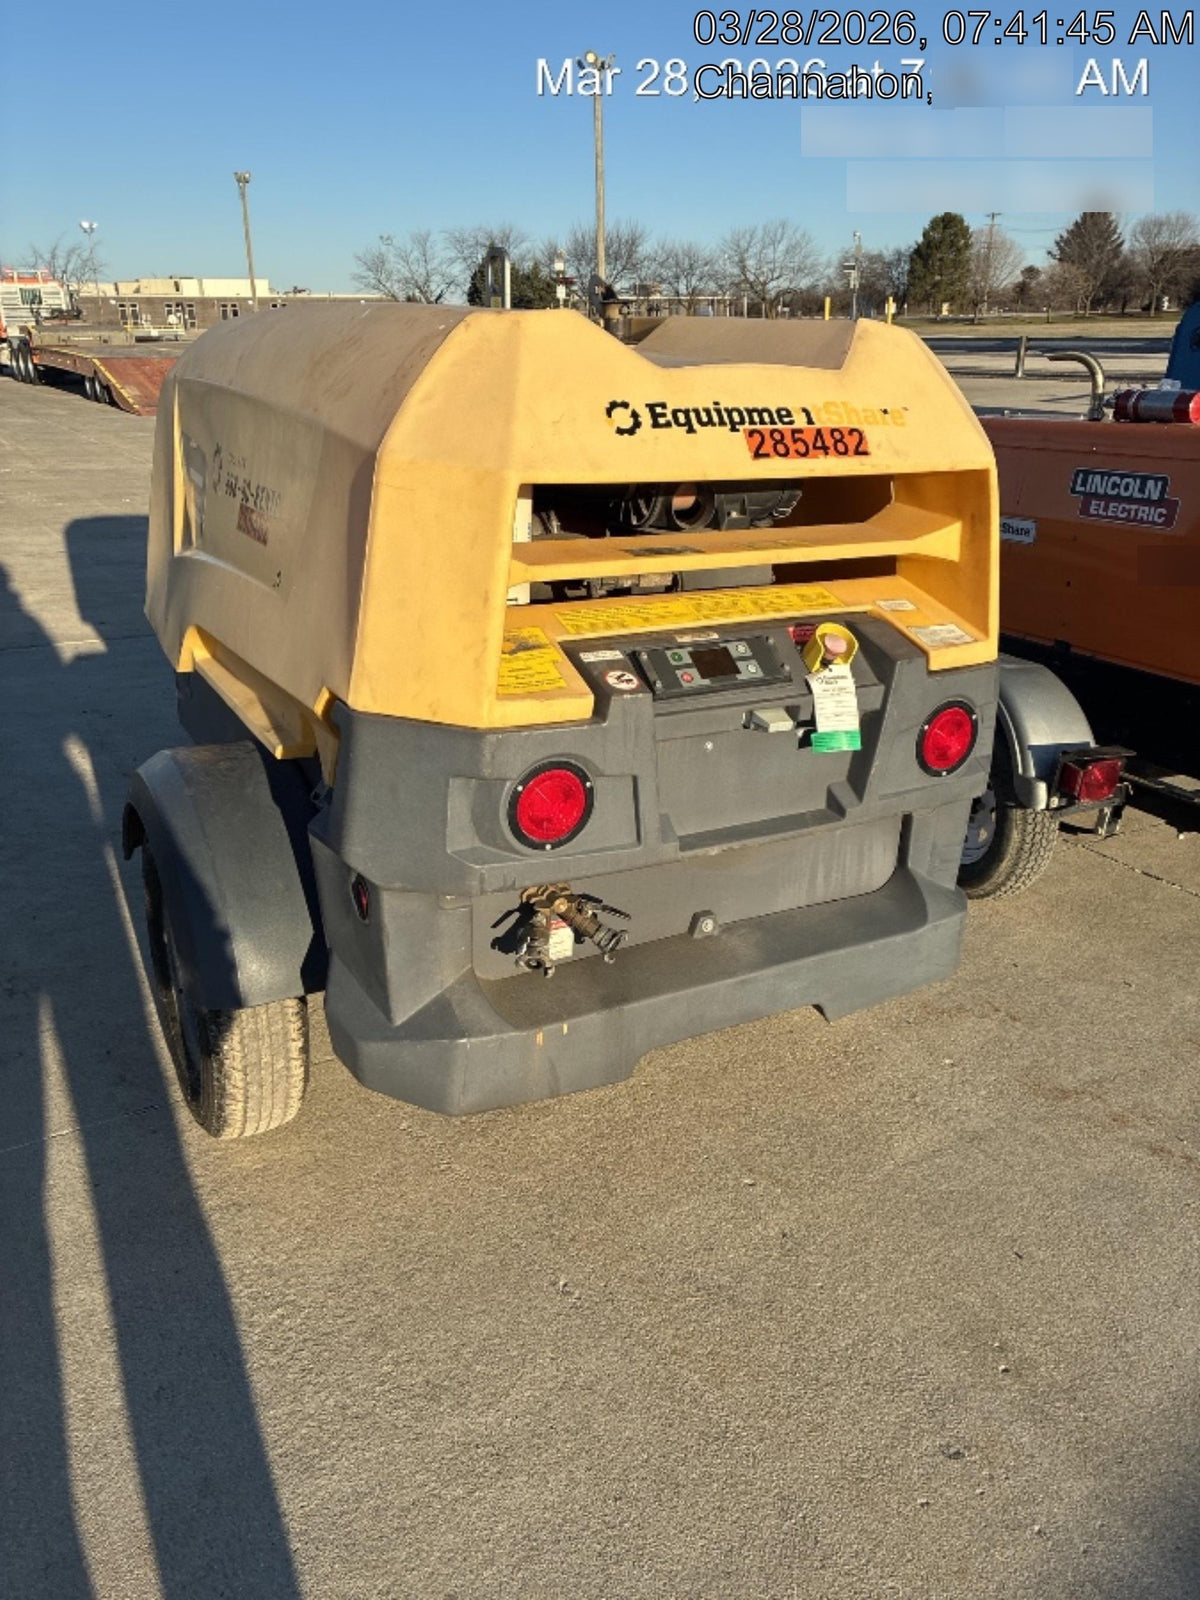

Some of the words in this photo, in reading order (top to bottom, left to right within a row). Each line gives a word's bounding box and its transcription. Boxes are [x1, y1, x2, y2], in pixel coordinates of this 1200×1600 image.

[747, 427, 871, 459] 285482
[1075, 472, 1163, 501] LINCOLN
[1089, 499, 1168, 524] ELECTRIC
